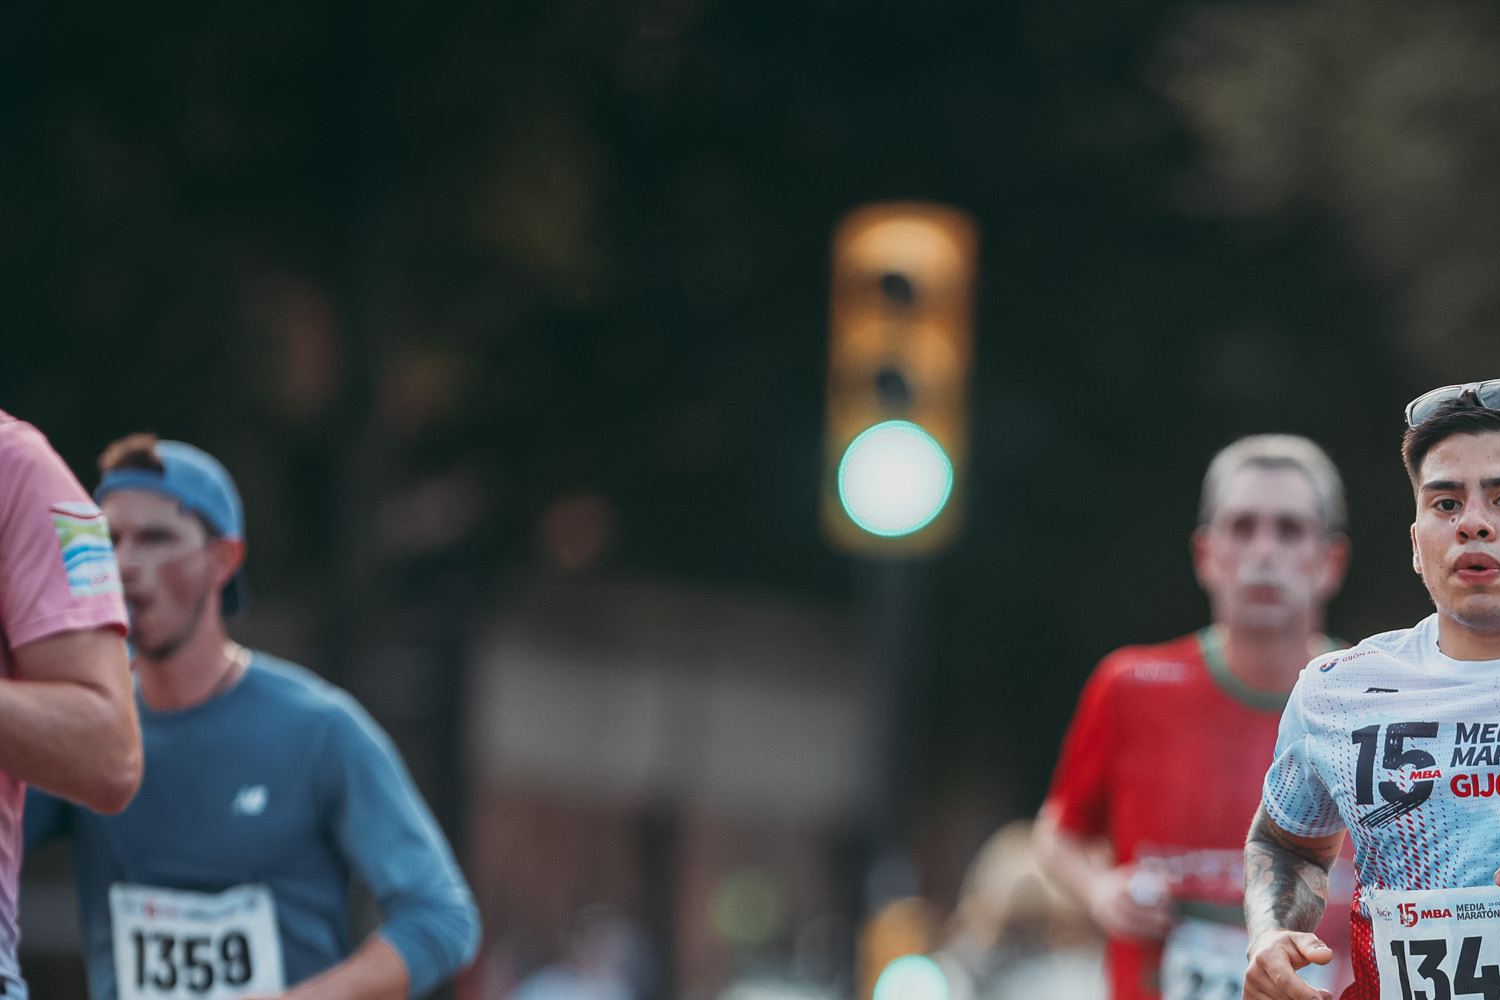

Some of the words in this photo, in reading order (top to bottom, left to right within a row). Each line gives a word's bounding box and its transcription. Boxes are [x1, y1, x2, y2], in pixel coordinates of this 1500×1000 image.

[1342, 652, 1366, 662] GIJÓN
[1351, 721, 1439, 806] 15
[1409, 770, 1442, 780] MBA
[1456, 903, 1485, 912] MEDIA
[1397, 903, 1418, 927] 15
[1421, 909, 1452, 919] MBA
[1456, 908, 1500, 920] MARATÓN
[133, 930, 252, 993] 1359
